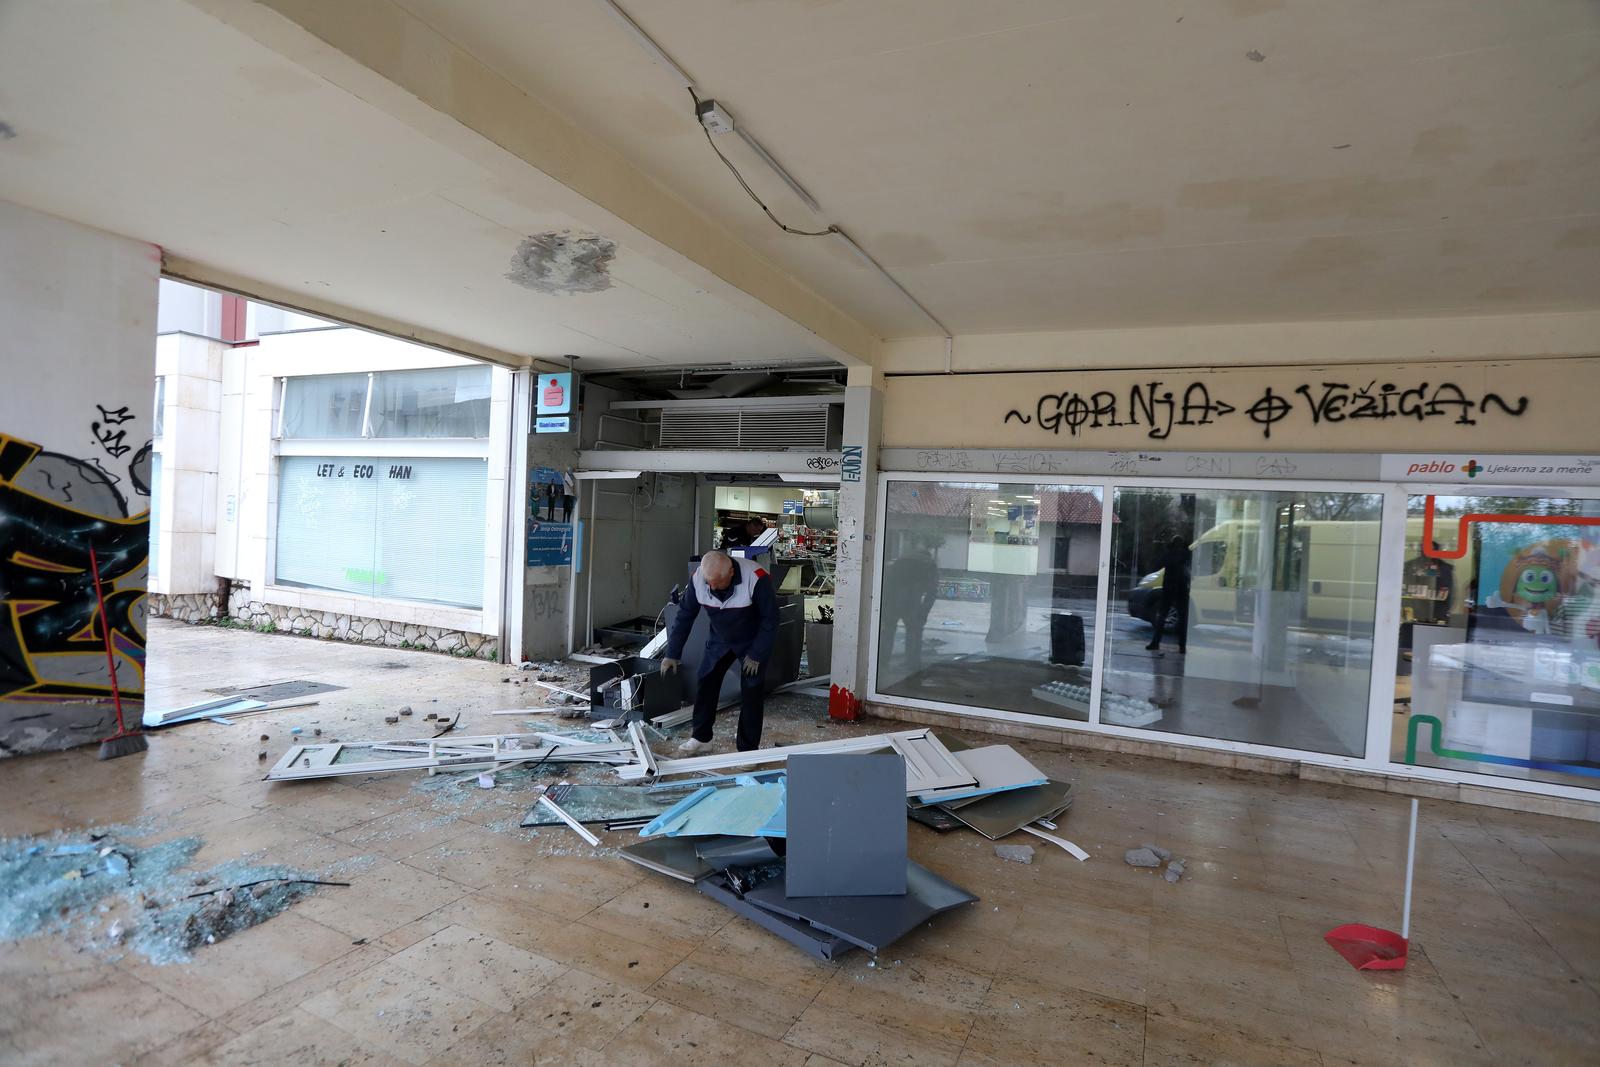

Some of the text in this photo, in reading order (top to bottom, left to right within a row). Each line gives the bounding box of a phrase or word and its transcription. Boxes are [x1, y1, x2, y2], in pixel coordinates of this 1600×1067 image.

[316, 464, 335, 477] LET
[353, 465, 374, 478] ECO
[388, 465, 412, 479] HAN
[1407, 461, 1456, 476] pablo
[1487, 464, 1537, 474] Ljekarna
[1556, 466, 1593, 474] mene
